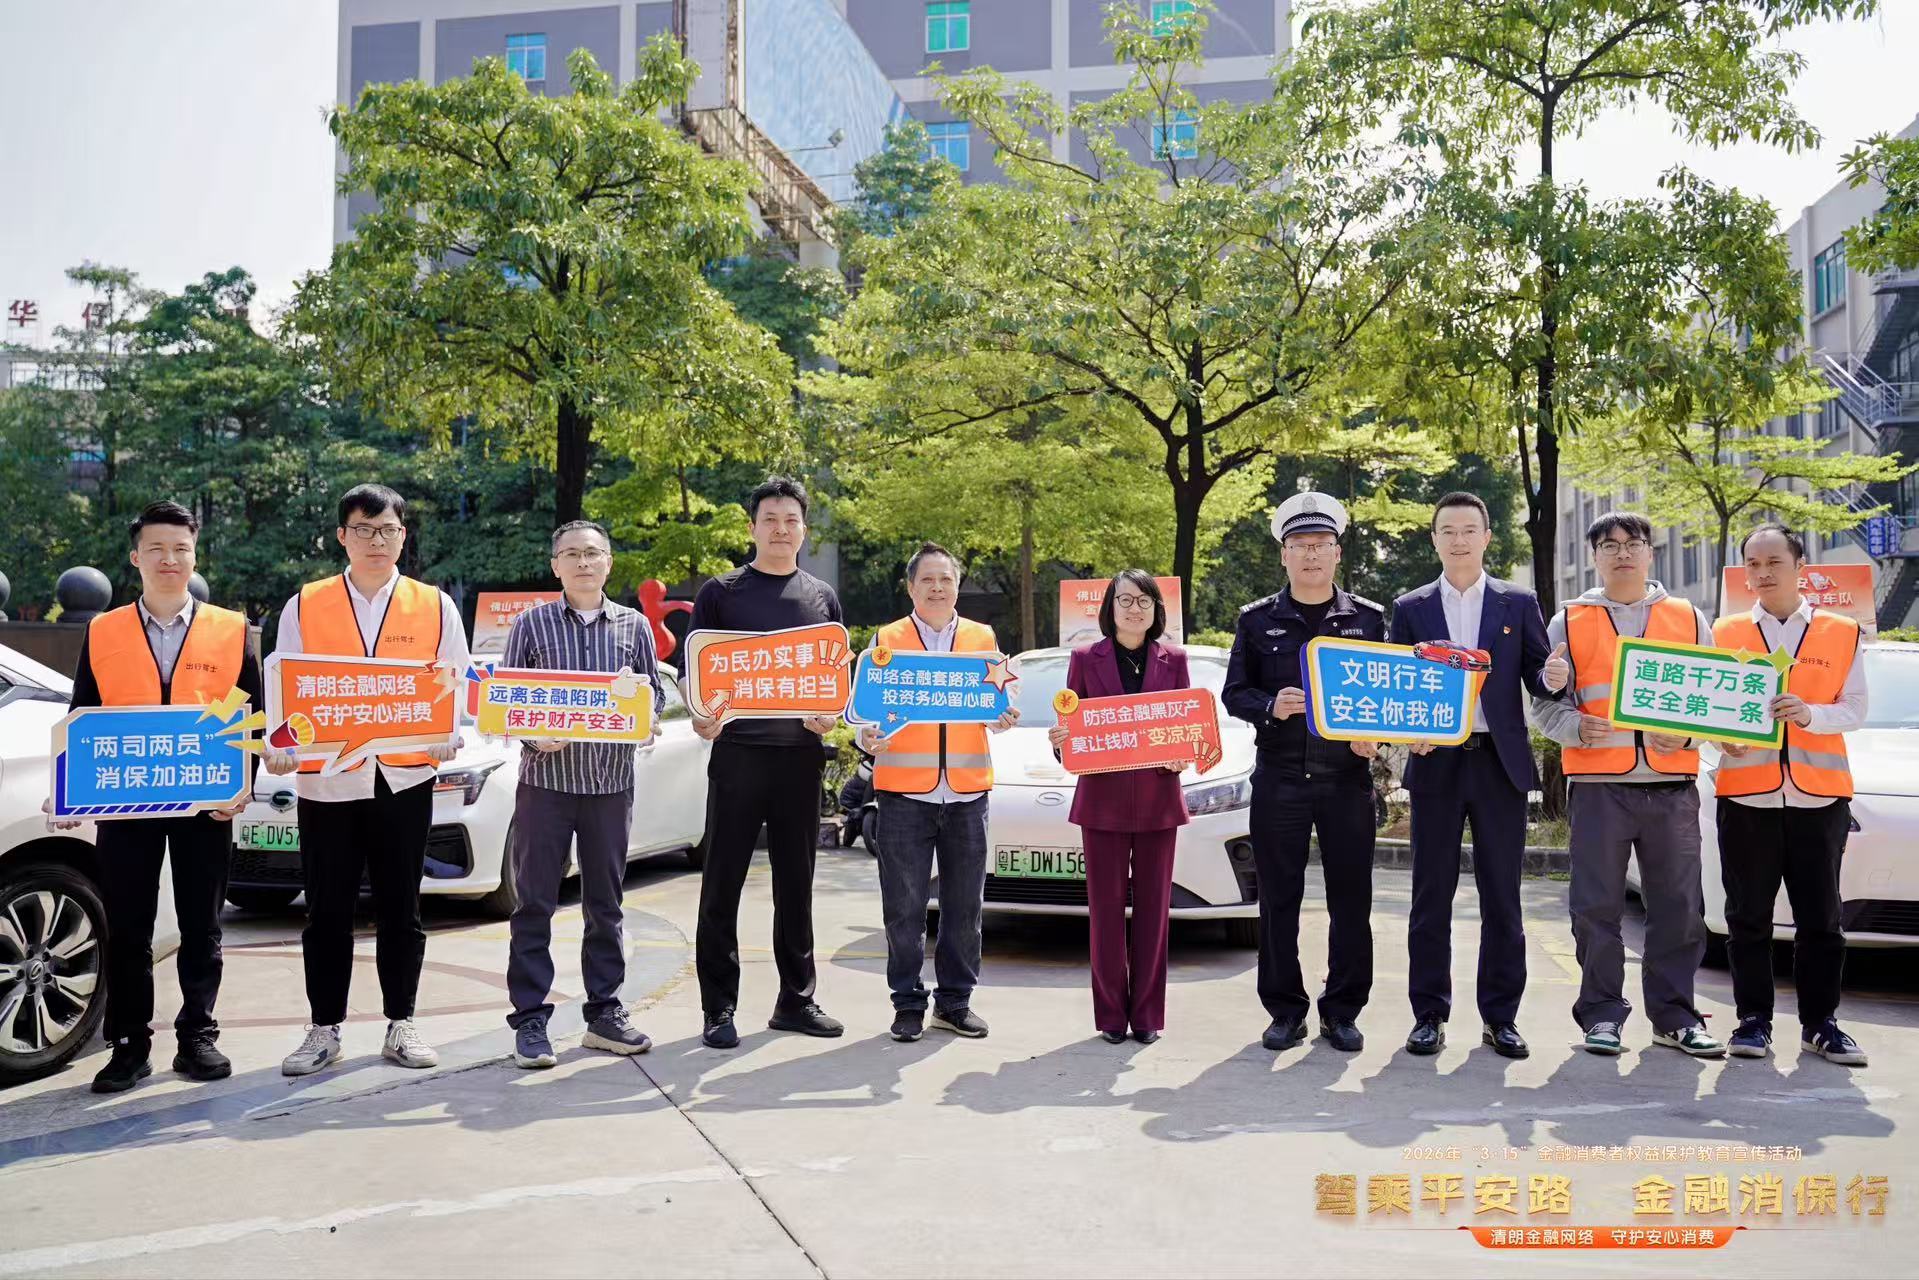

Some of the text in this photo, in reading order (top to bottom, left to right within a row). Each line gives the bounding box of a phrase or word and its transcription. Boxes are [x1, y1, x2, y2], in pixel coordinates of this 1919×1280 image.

[1077, 590, 1107, 602] 佛山
[709, 643, 815, 673] 为民办实事
[296, 675, 417, 698] 清朗金融网络
[733, 674, 838, 699] 消保有担当
[867, 668, 980, 688] 网络金融套路深
[1340, 658, 1444, 694] 文明行车
[1634, 659, 1767, 695] 道路千万条
[489, 685, 617, 708] 远离金融陷阱，
[882, 689, 996, 709] 投资务必留心眼
[1632, 687, 1764, 724] 安全第一条
[312, 702, 433, 726] 守护安心消费
[507, 709, 634, 730] 保护财产安全！
[1083, 700, 1200, 727] 防范金融黑灰产
[1331, 694, 1455, 728] 安全你我他
[80, 733, 216, 759] “两司两员”
[95, 763, 232, 790] 消保加油站
